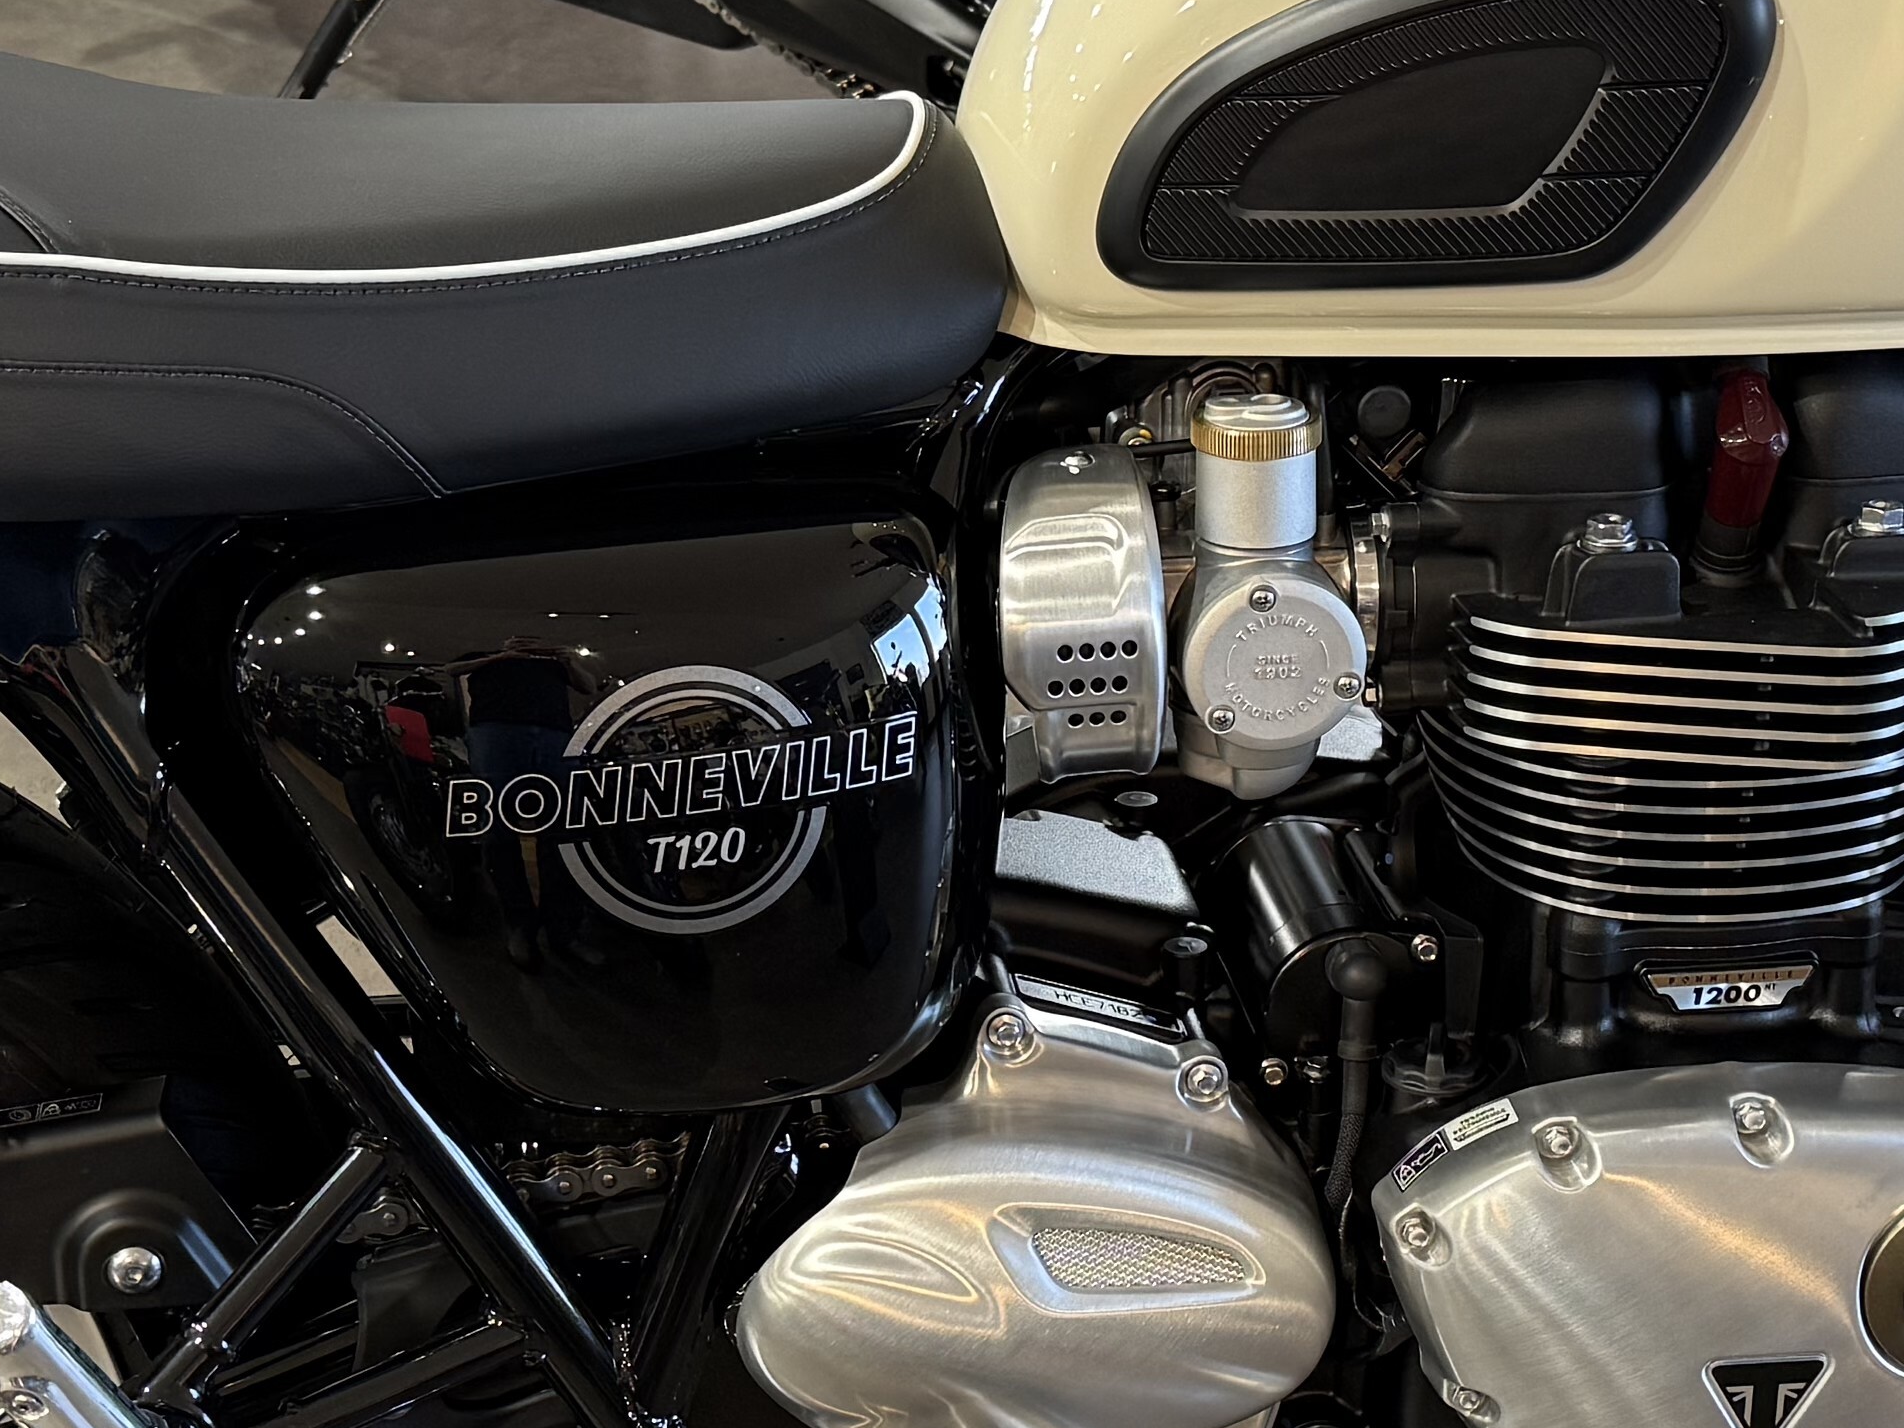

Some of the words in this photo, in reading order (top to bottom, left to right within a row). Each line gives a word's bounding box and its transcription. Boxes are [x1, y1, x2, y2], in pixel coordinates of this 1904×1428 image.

[1235, 613, 1319, 642] TRIUMPH
[1256, 653, 1301, 665] SINCE
[1254, 665, 1302, 680] 1902
[1224, 676, 1331, 721] MOTORCYCLES
[445, 711, 919, 839] BONNEVILLE
[645, 825, 747, 875] T120
[1668, 969, 1794, 986] BONNEVILLE
[1693, 983, 1762, 1006] 1200
